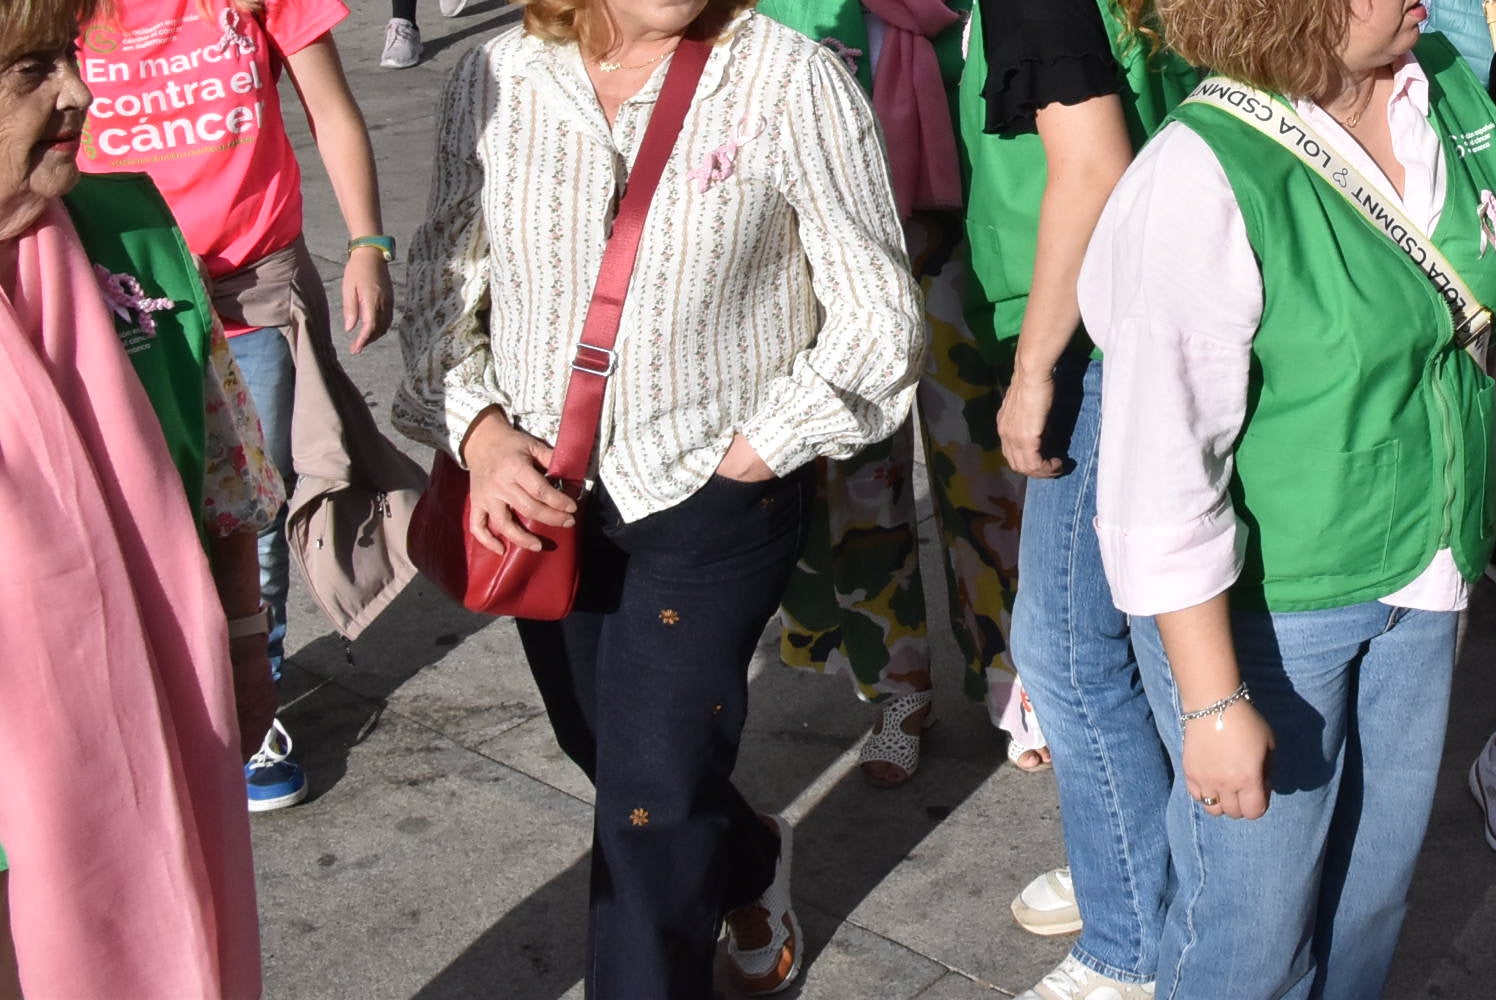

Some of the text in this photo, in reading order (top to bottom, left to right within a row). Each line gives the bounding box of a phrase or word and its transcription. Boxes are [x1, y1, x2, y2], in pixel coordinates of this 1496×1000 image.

[85, 57, 130, 83] En
[89, 60, 262, 119] contra el
[98, 100, 266, 156] cáncer
[1196, 82, 1332, 168] LOLA CSDMN
[1351, 186, 1428, 267] CSDMNT
